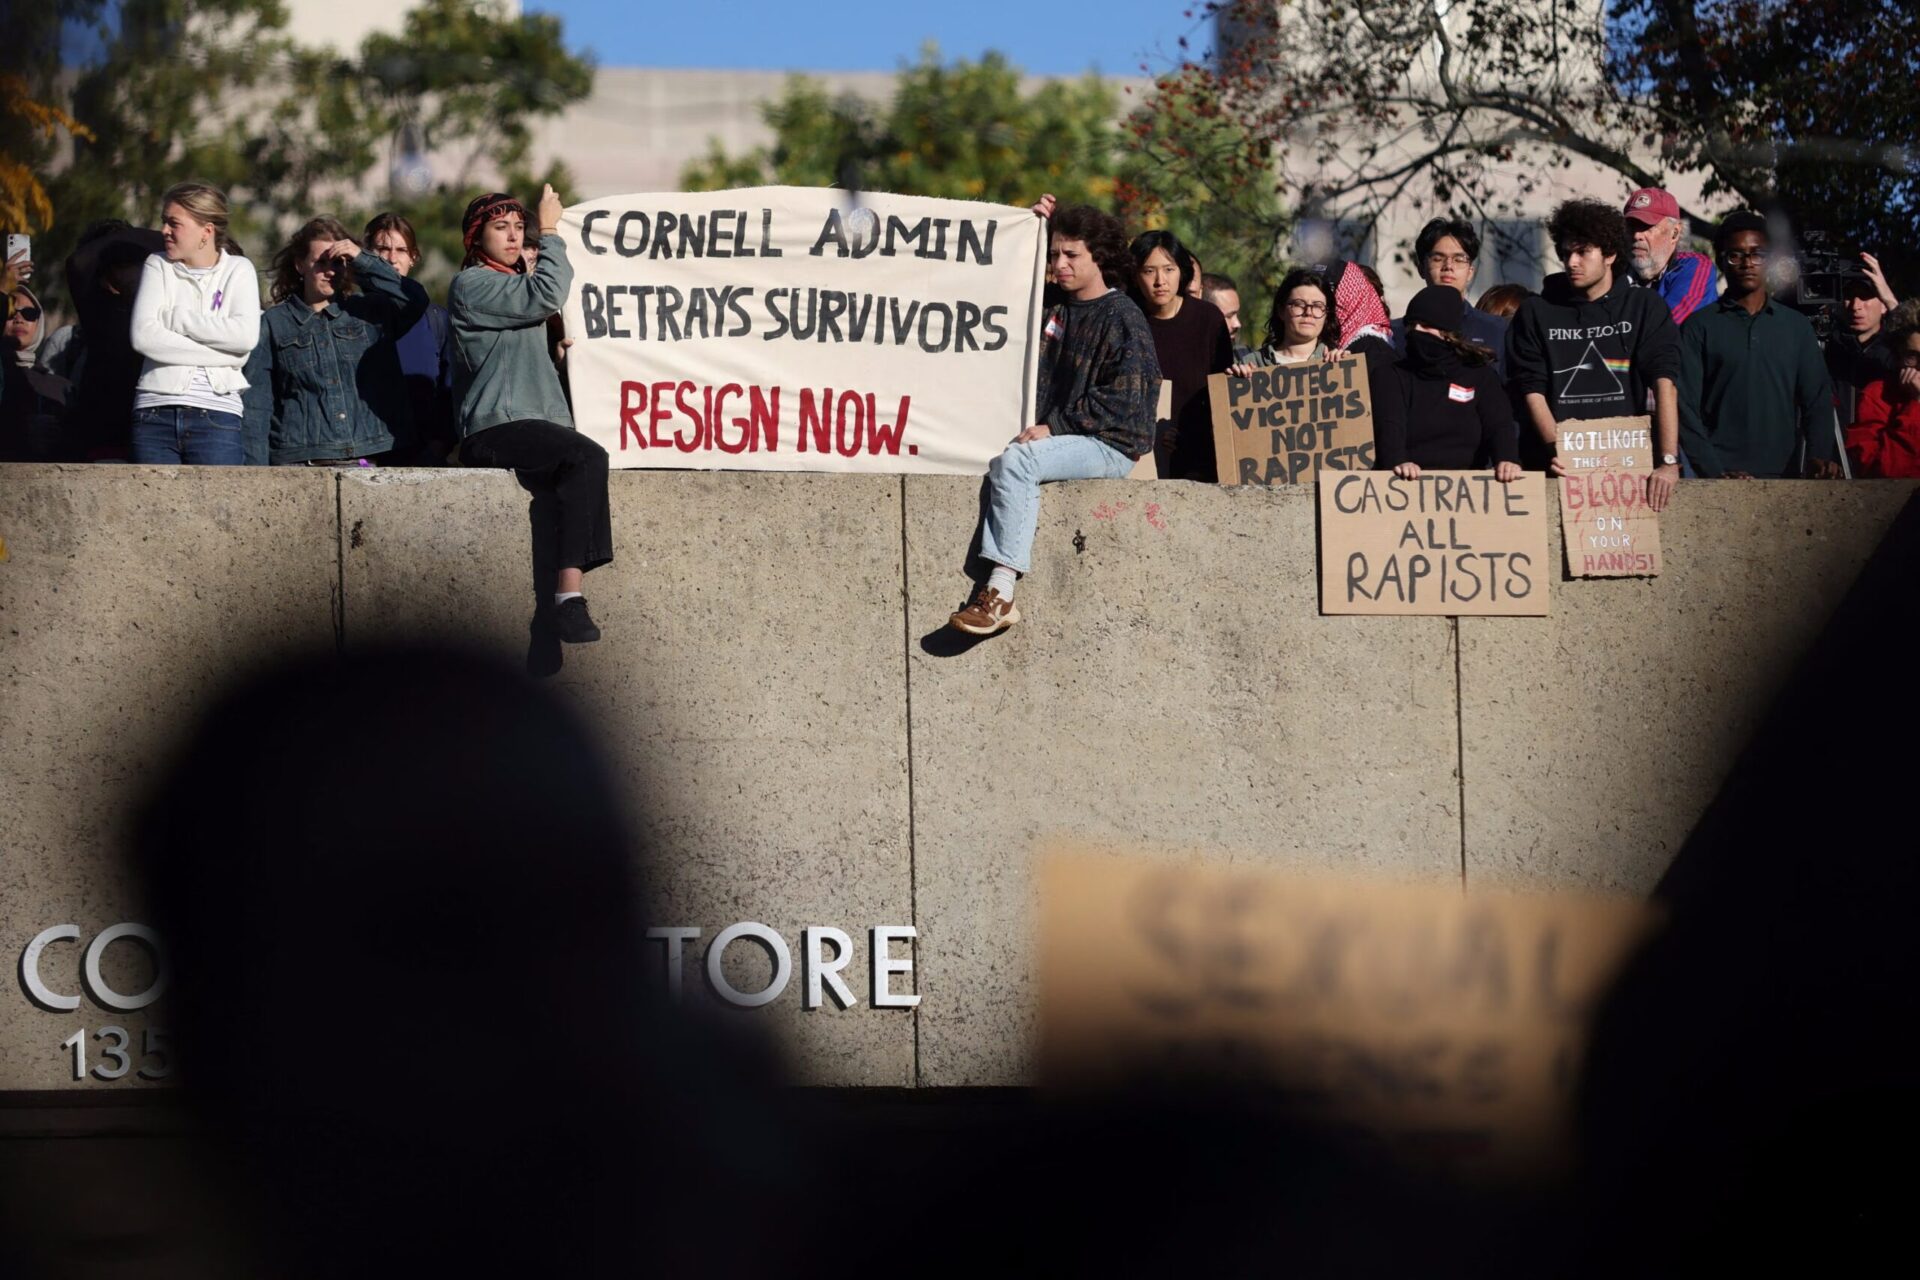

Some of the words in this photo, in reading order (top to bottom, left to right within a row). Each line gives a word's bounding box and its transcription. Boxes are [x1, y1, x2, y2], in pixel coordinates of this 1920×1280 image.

[581, 208, 783, 260] CORNELL
[809, 207, 997, 265] ADMIN
[581, 283, 753, 341] BETRAYS
[763, 287, 1008, 353] SURVIVORS
[1549, 328, 1583, 340] PINK
[1228, 359, 1357, 407] PROTECT
[620, 381, 780, 454] RESIGN
[798, 388, 919, 458] NOW.
[1272, 421, 1338, 454] NOT
[1239, 441, 1374, 485] RAPISTS
[1572, 456, 1608, 468] THERE
[1622, 456, 1634, 467] IS
[1334, 475, 1529, 516] CASTRATE
[1399, 517, 1472, 550] ALL
[1590, 534, 1631, 548] YOUR
[1597, 517, 1622, 531] ON
[1347, 551, 1532, 604] RAPISTS
[1584, 553, 1655, 572] HANDS!
[645, 921, 922, 1008] TORE
